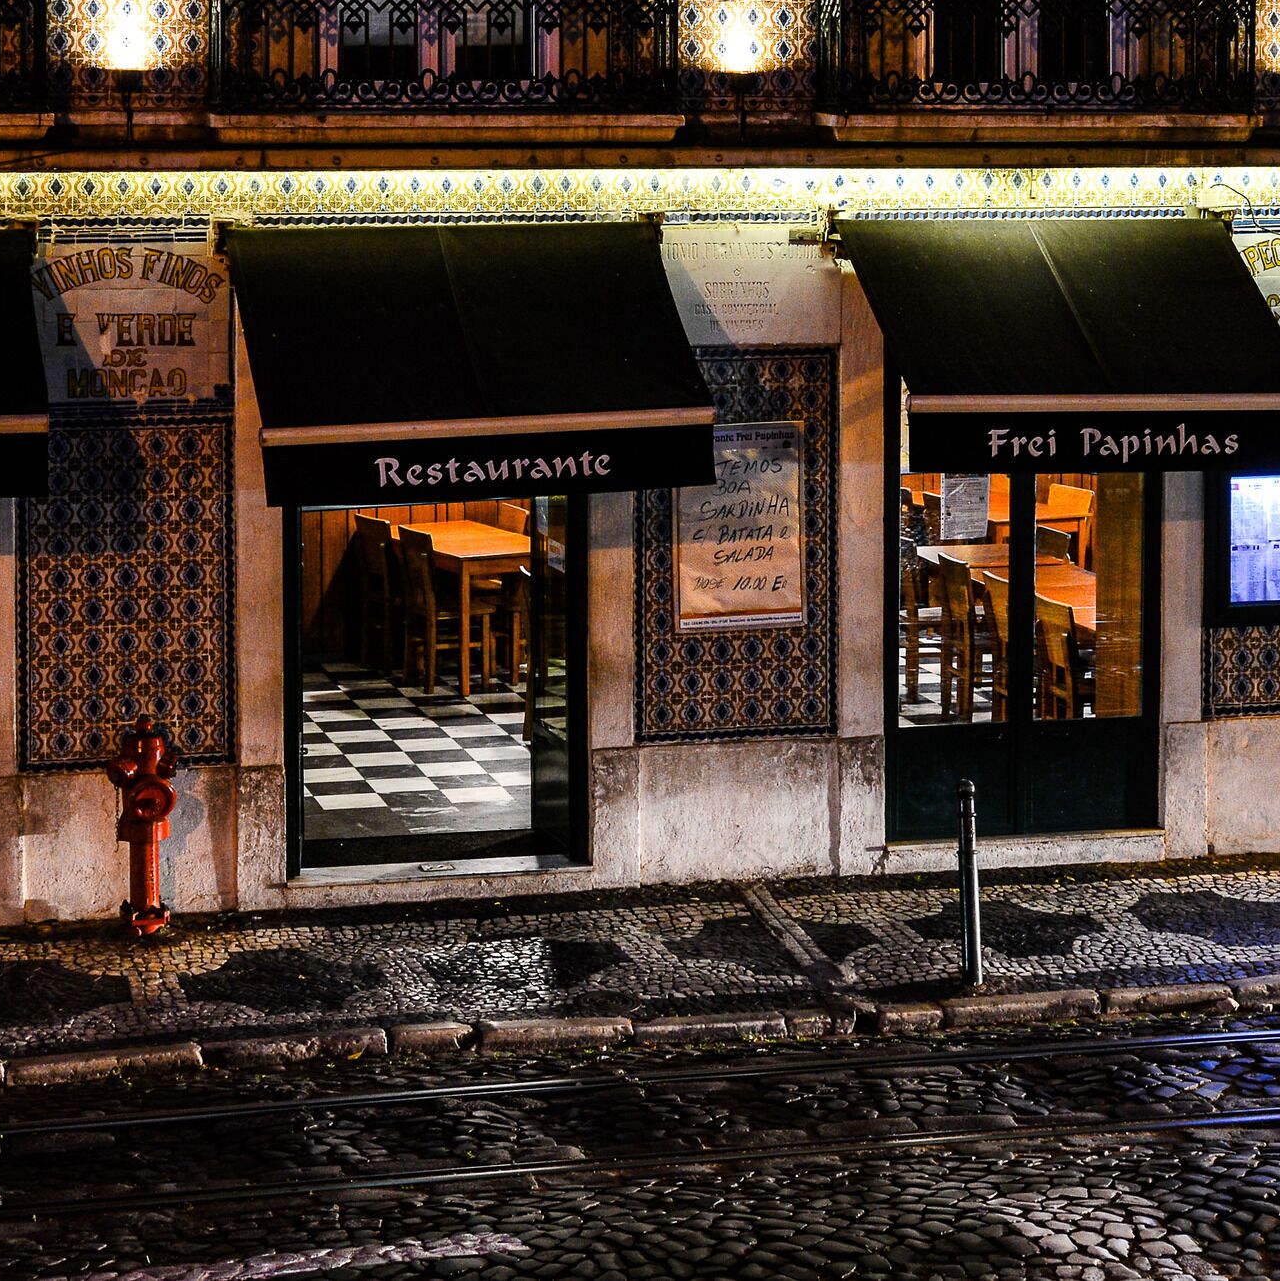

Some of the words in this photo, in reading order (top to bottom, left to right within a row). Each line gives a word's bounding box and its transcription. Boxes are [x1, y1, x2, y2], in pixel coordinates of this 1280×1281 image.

[32, 247, 133, 301] VINHOS
[140, 247, 225, 304] FINOS
[704, 281, 770, 300] SOBRINHOS
[56, 313, 76, 346] E
[95, 313, 196, 346] VERDE
[103, 348, 148, 367] DE
[988, 429, 1057, 457] Frei
[1080, 423, 1239, 464] Papinhas
[374, 450, 611, 487] Restaurante
[716, 458, 782, 476] TEMOS
[717, 525, 773, 546] BATATA
[714, 546, 774, 565] SALADA
